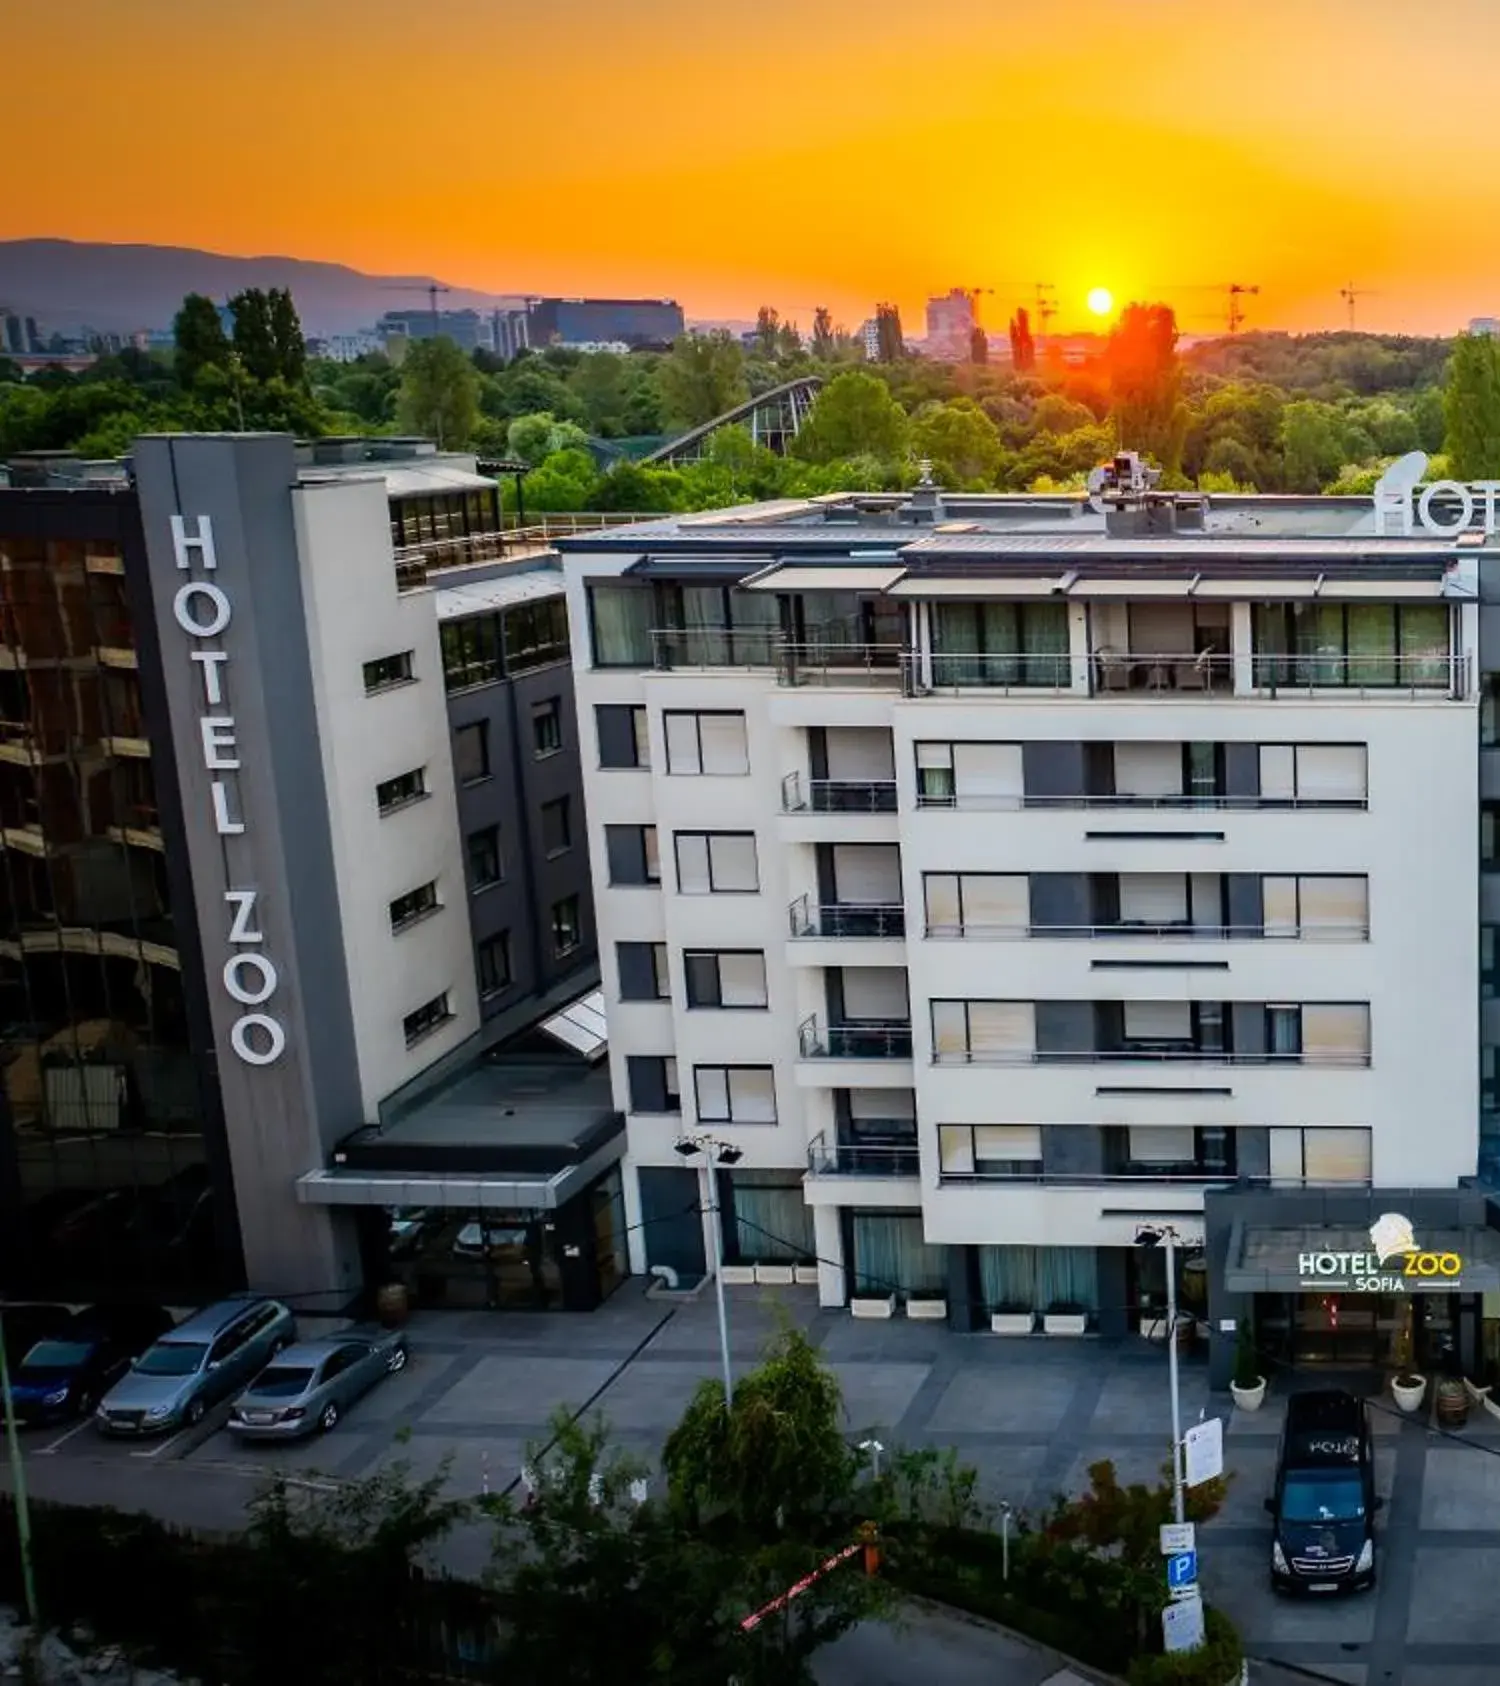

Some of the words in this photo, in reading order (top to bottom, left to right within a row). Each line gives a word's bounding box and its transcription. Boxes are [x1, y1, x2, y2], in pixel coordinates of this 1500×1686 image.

[170, 515, 246, 835] HOTEL
[223, 891, 286, 1065] ZOO
[1299, 1252, 1377, 1275] HOTEL
[1404, 1253, 1462, 1276] ZOO
[1355, 1276, 1405, 1292] SOFIA
[1175, 1556, 1191, 1581] P
